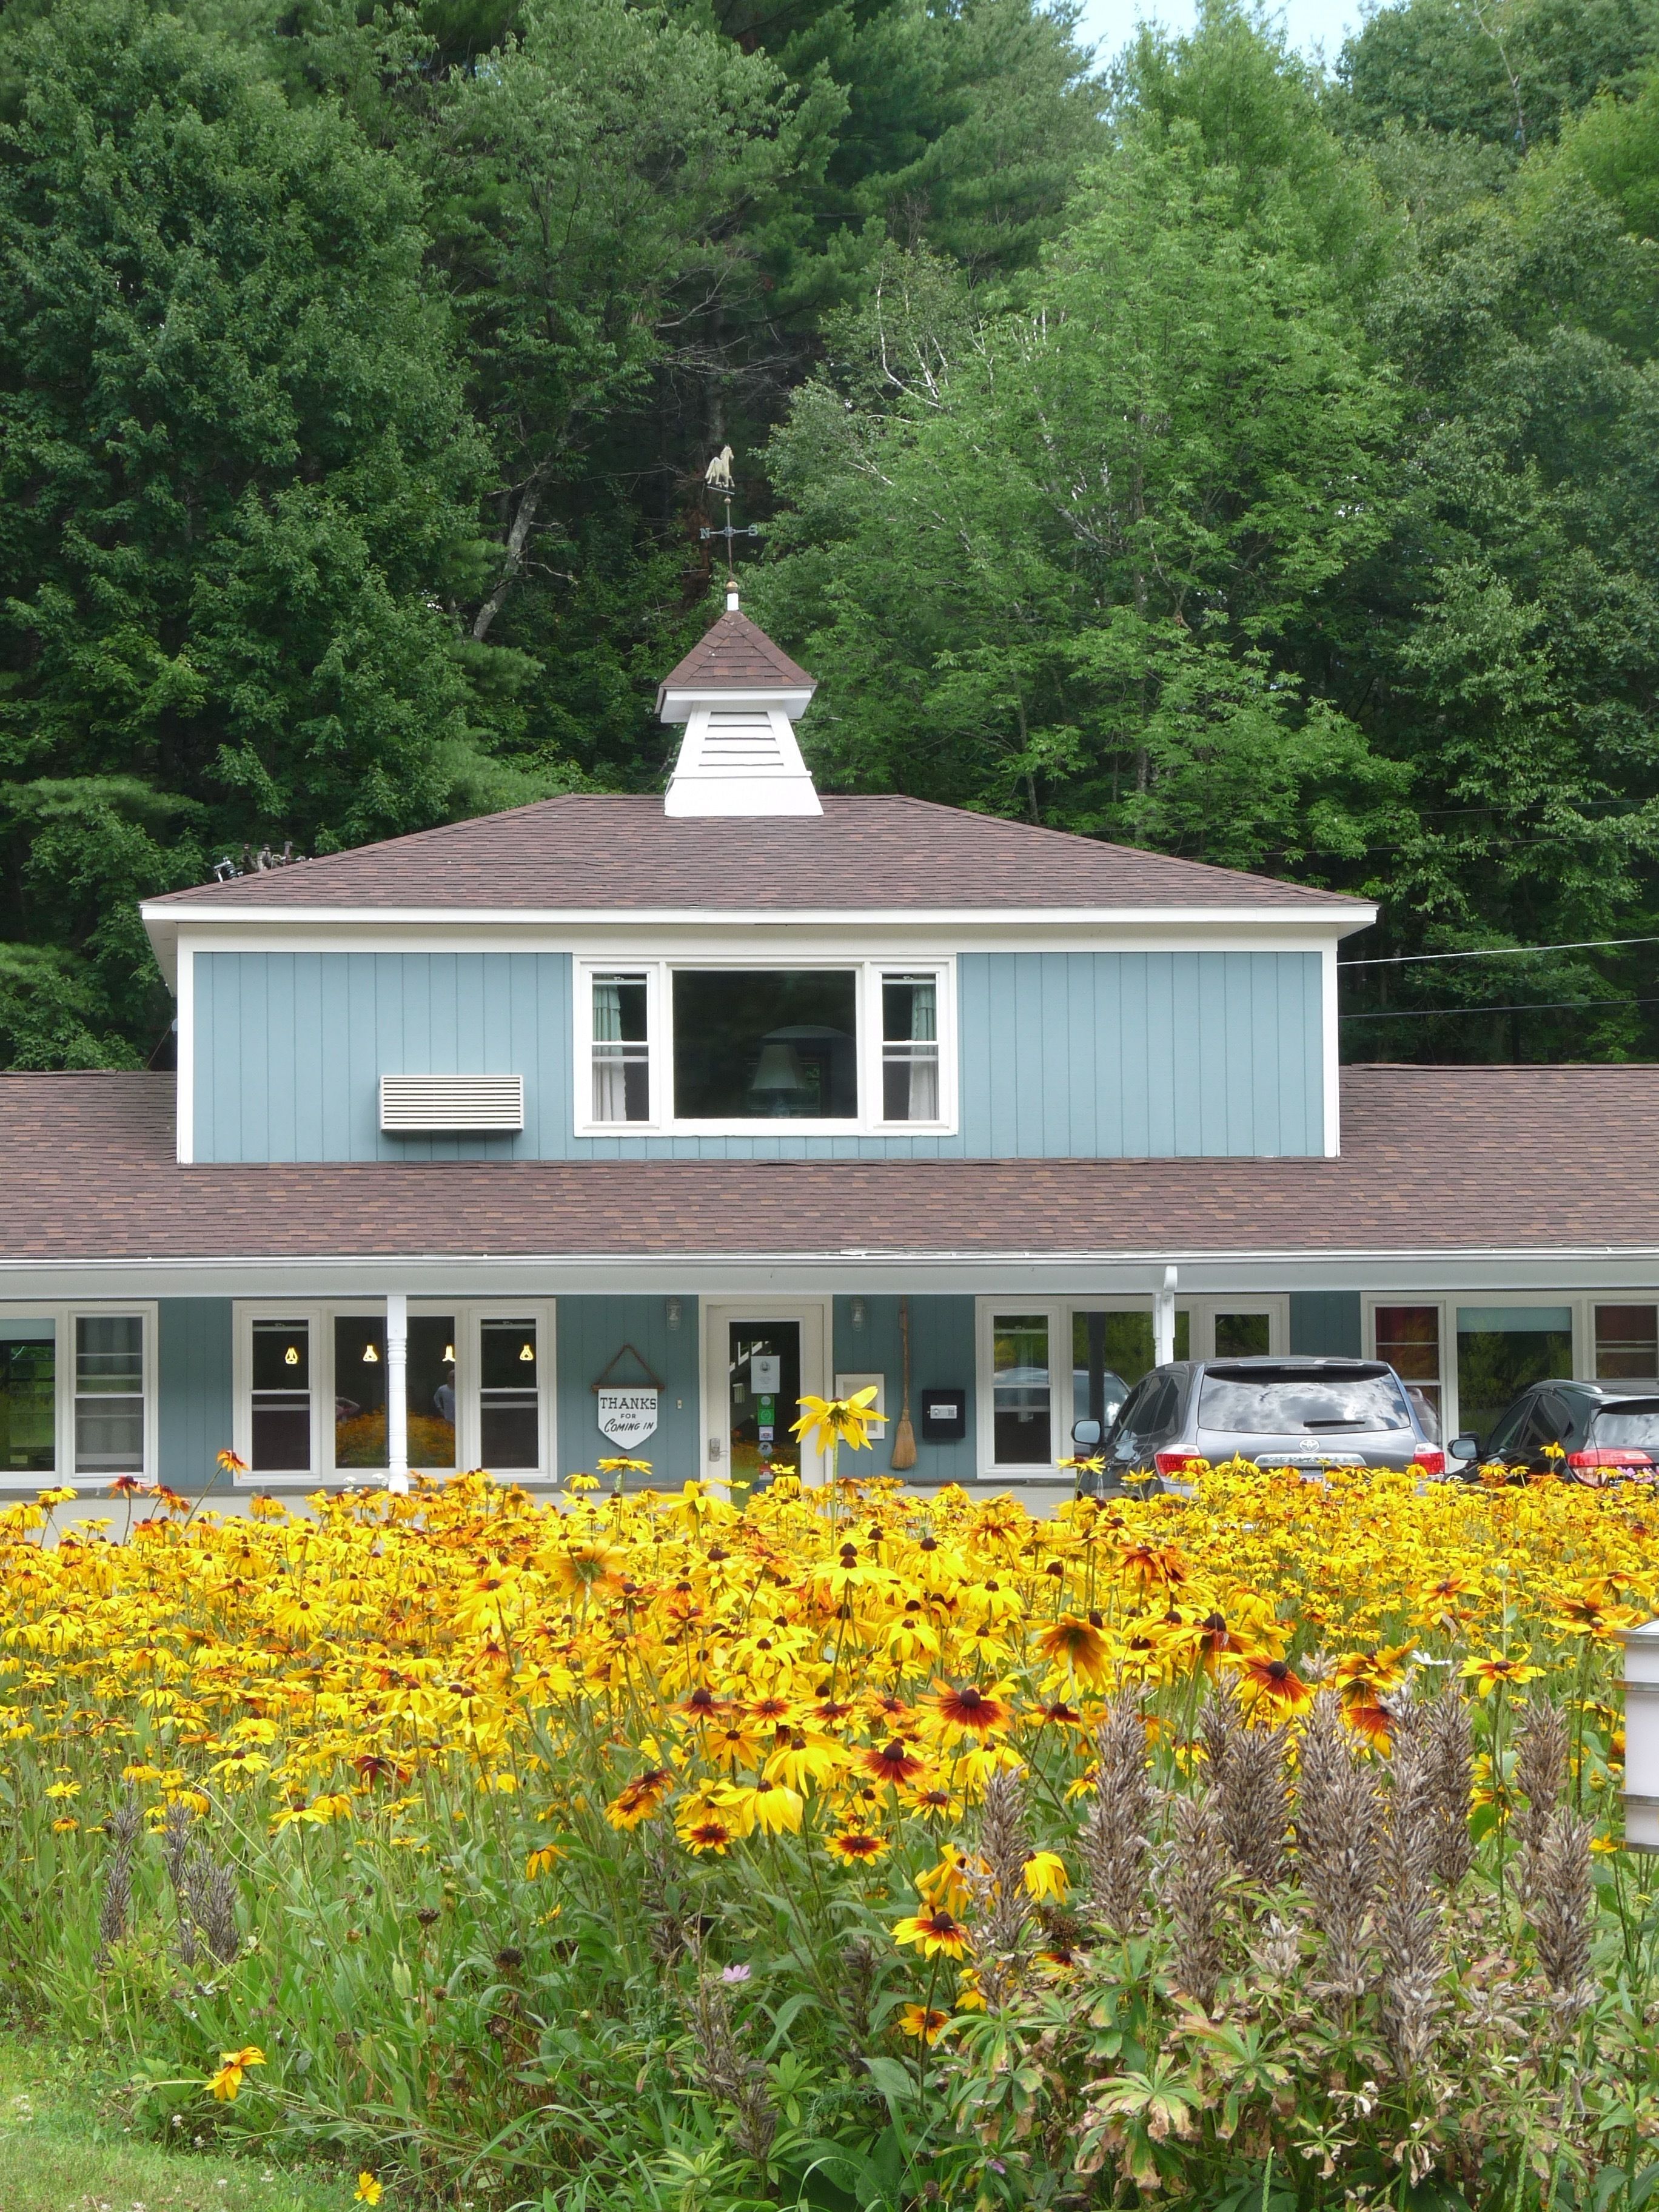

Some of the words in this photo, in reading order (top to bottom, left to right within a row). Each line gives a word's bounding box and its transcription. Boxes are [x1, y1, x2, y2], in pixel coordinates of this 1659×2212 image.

[699, 528, 711, 539] N
[748, 523, 759, 537] S
[600, 1397, 657, 1410] THANKS
[604, 1418, 640, 1433] COMING
